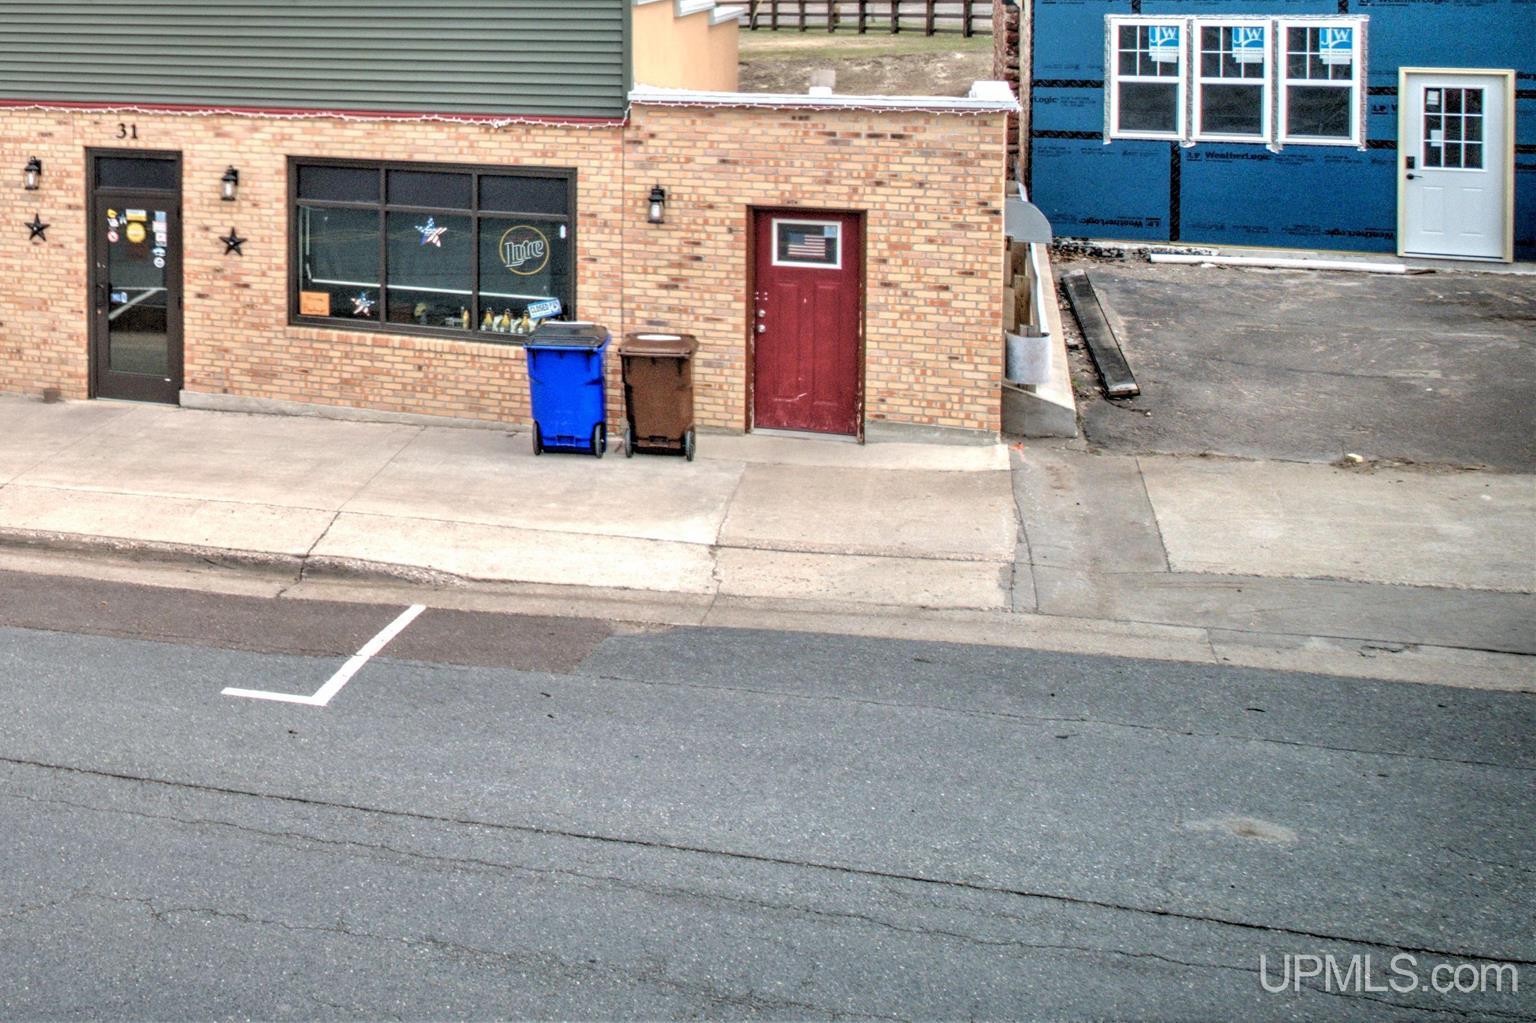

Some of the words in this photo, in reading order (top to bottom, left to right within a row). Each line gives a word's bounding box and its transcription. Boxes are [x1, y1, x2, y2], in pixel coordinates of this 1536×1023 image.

[116, 122, 138, 139] 31
[1205, 150, 1272, 161] WeatherLogic
[1079, 217, 1144, 228] WeatherLogic
[504, 240, 545, 268] Lite
